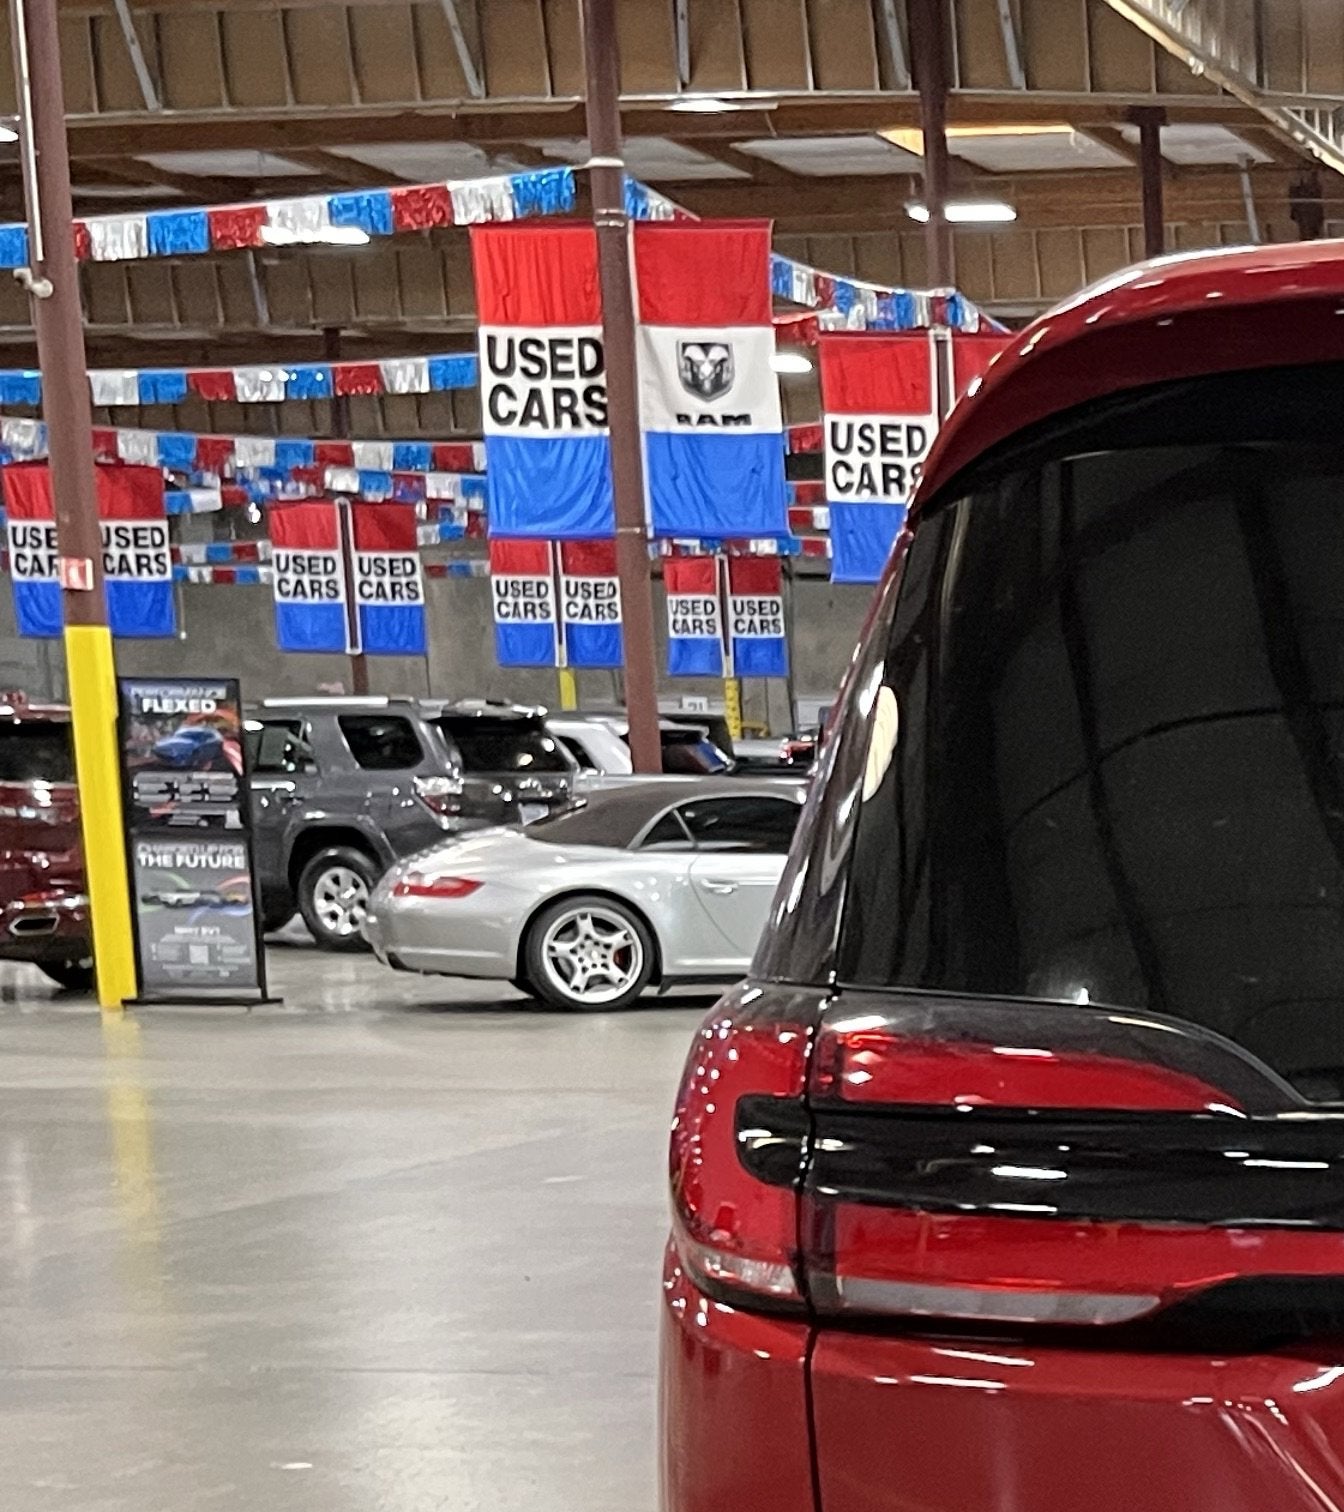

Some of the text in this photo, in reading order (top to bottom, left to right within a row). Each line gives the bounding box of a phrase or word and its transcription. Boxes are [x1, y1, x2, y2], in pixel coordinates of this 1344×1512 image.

[486, 334, 604, 382] USED
[487, 383, 608, 429] CARS
[675, 413, 752, 426] RAM
[830, 421, 928, 458] USED
[11, 526, 57, 549] USE
[15, 553, 59, 577] CAR
[103, 553, 167, 575] CARS
[275, 554, 337, 575] USED
[358, 557, 417, 577] USED
[277, 578, 340, 599] CARS
[358, 580, 420, 600] CARS
[495, 580, 549, 599] USED
[565, 581, 617, 600] USED
[496, 601, 551, 620] CARS
[565, 601, 619, 620] CARS
[670, 599, 716, 616] USED
[733, 600, 780, 616] USED
[672, 618, 717, 635] CARS
[734, 619, 781, 634] CARS
[142, 698, 217, 714] FLEXED
[138, 854, 173, 868] THE
[176, 855, 245, 869] FUTURE
